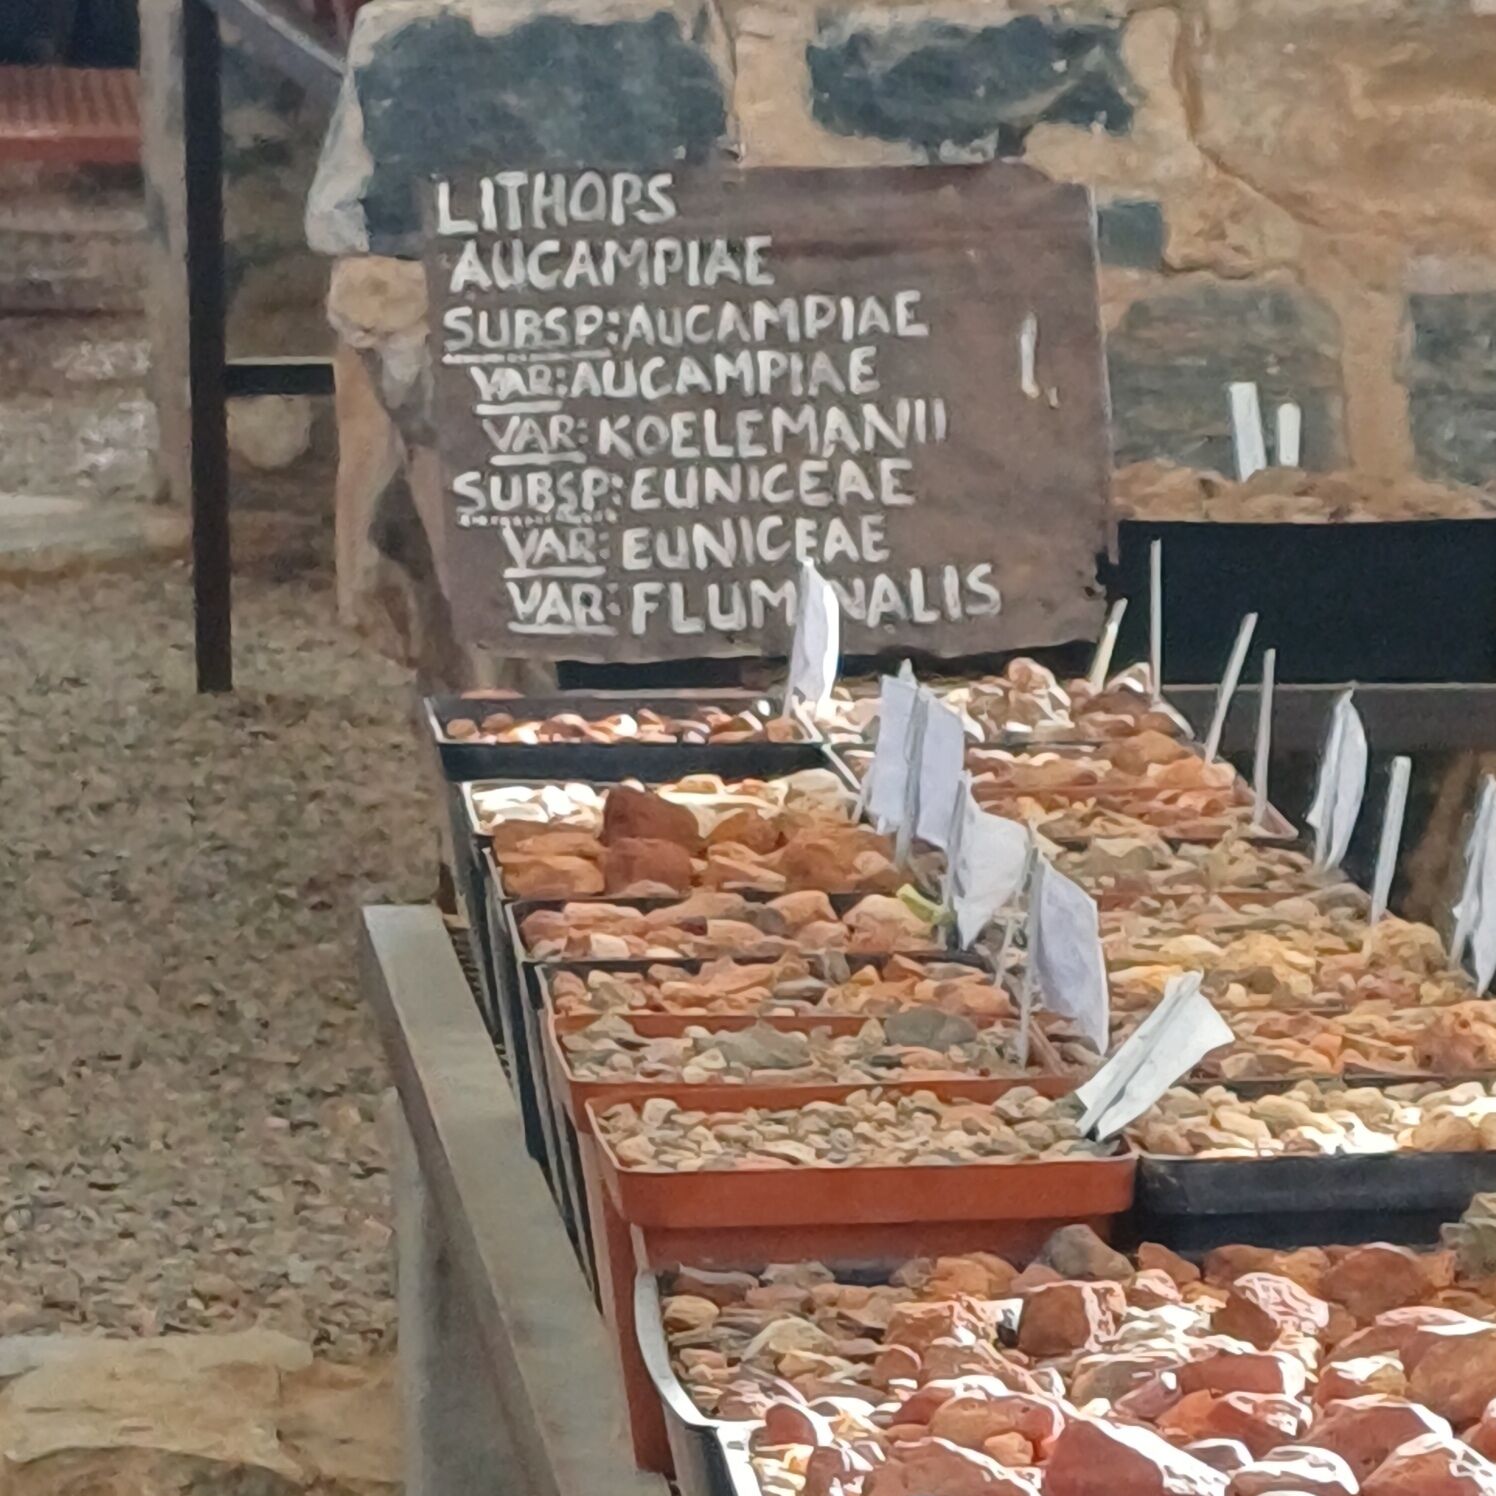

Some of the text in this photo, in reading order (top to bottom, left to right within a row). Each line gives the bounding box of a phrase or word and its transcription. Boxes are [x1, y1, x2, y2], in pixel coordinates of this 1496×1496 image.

[436, 172, 677, 236] LITHOPS
[450, 235, 776, 293] AUCAMPIAE
[598, 398, 947, 460] KOELEMANII
[630, 458, 915, 509] EUNICEAE
[622, 514, 890, 571] EUNICEAE
[630, 563, 1000, 636] FLUMNALIS
